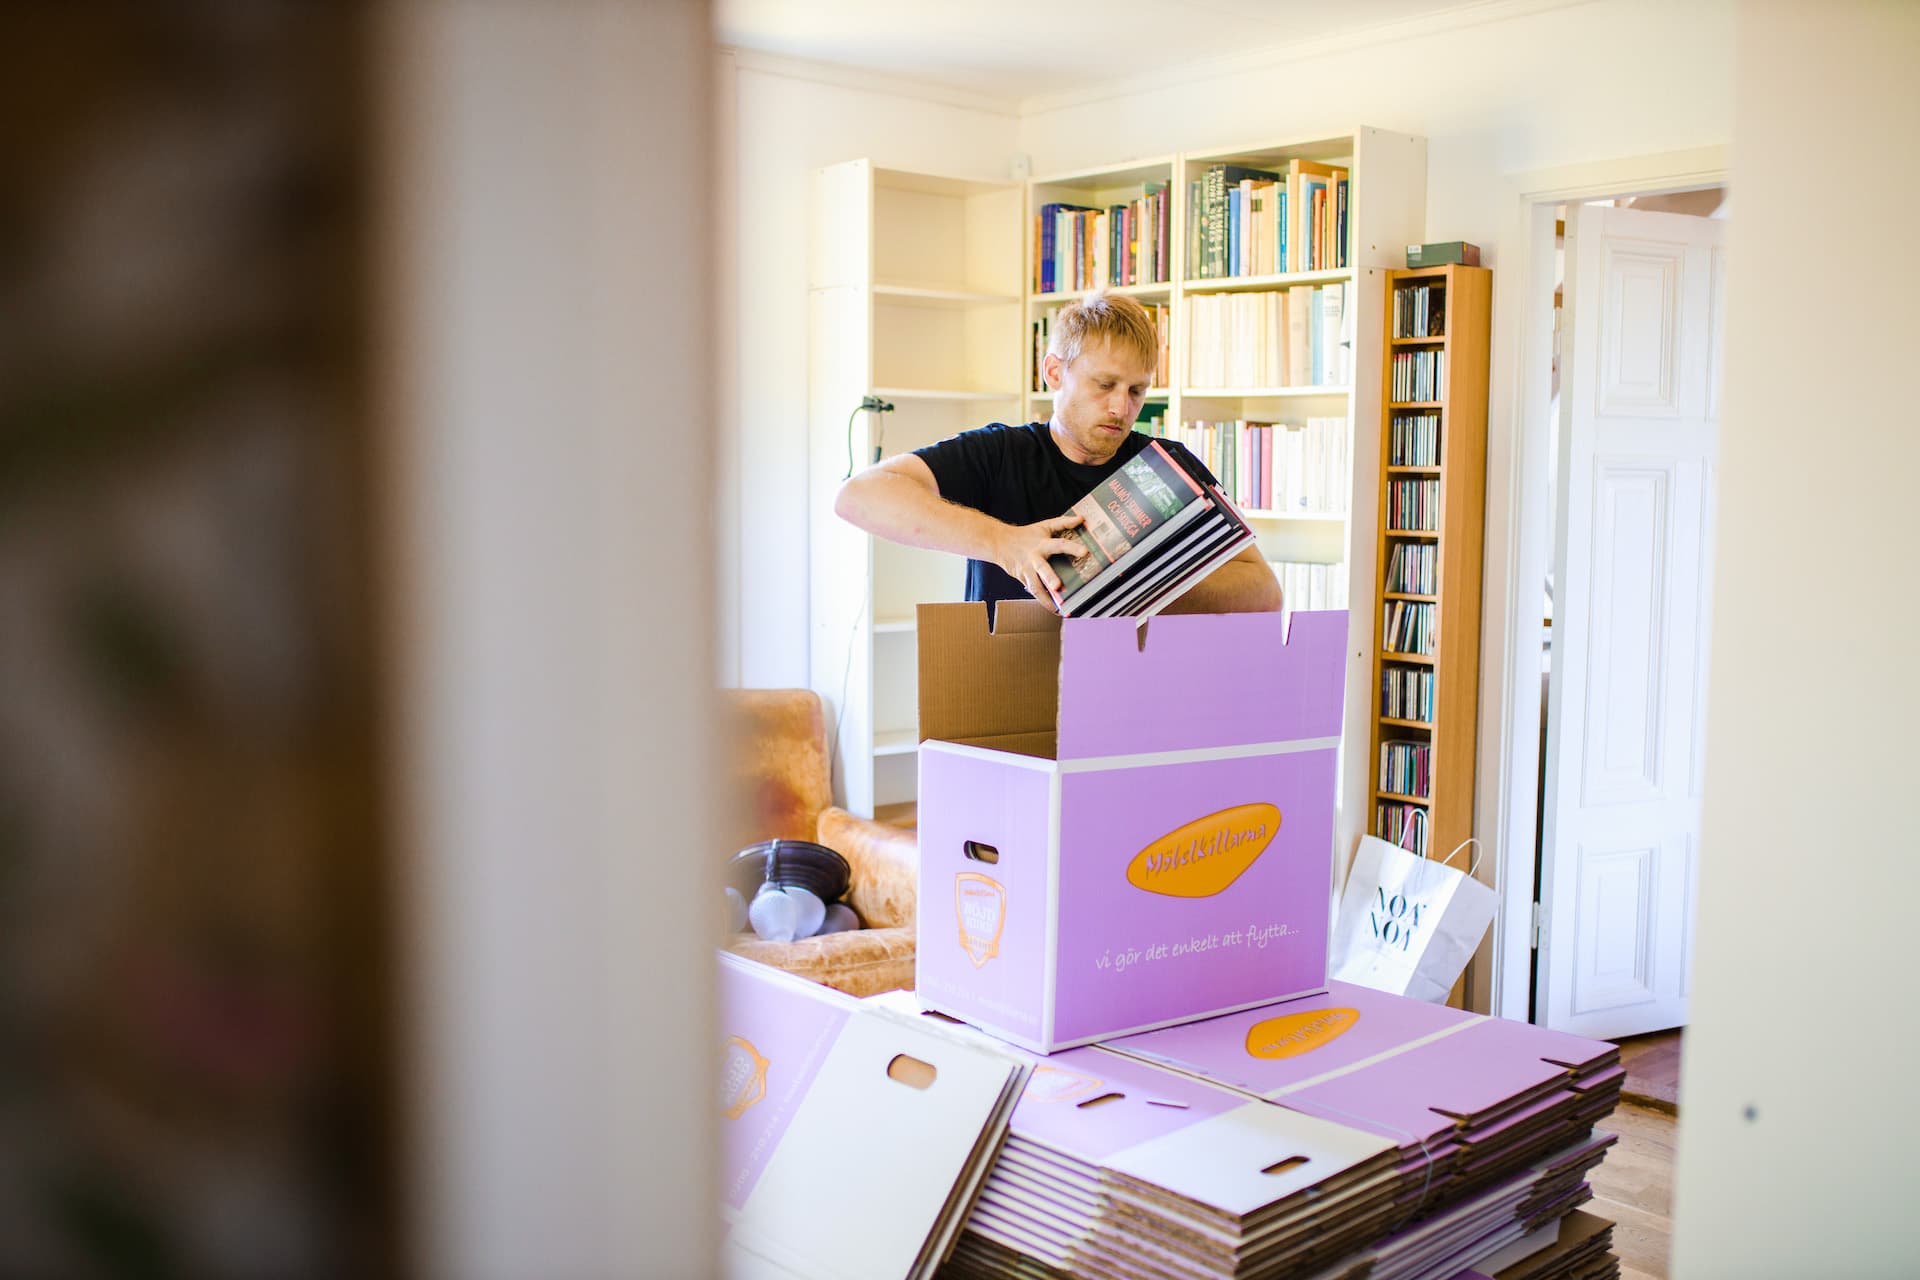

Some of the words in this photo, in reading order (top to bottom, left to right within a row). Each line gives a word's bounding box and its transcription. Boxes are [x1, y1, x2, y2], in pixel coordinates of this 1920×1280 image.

[1096, 950, 1112, 970] vi
[1116, 948, 1141, 972] gör
[1146, 944, 1168, 961] det
[1172, 935, 1219, 957] enkelt
[1222, 930, 1242, 946] att
